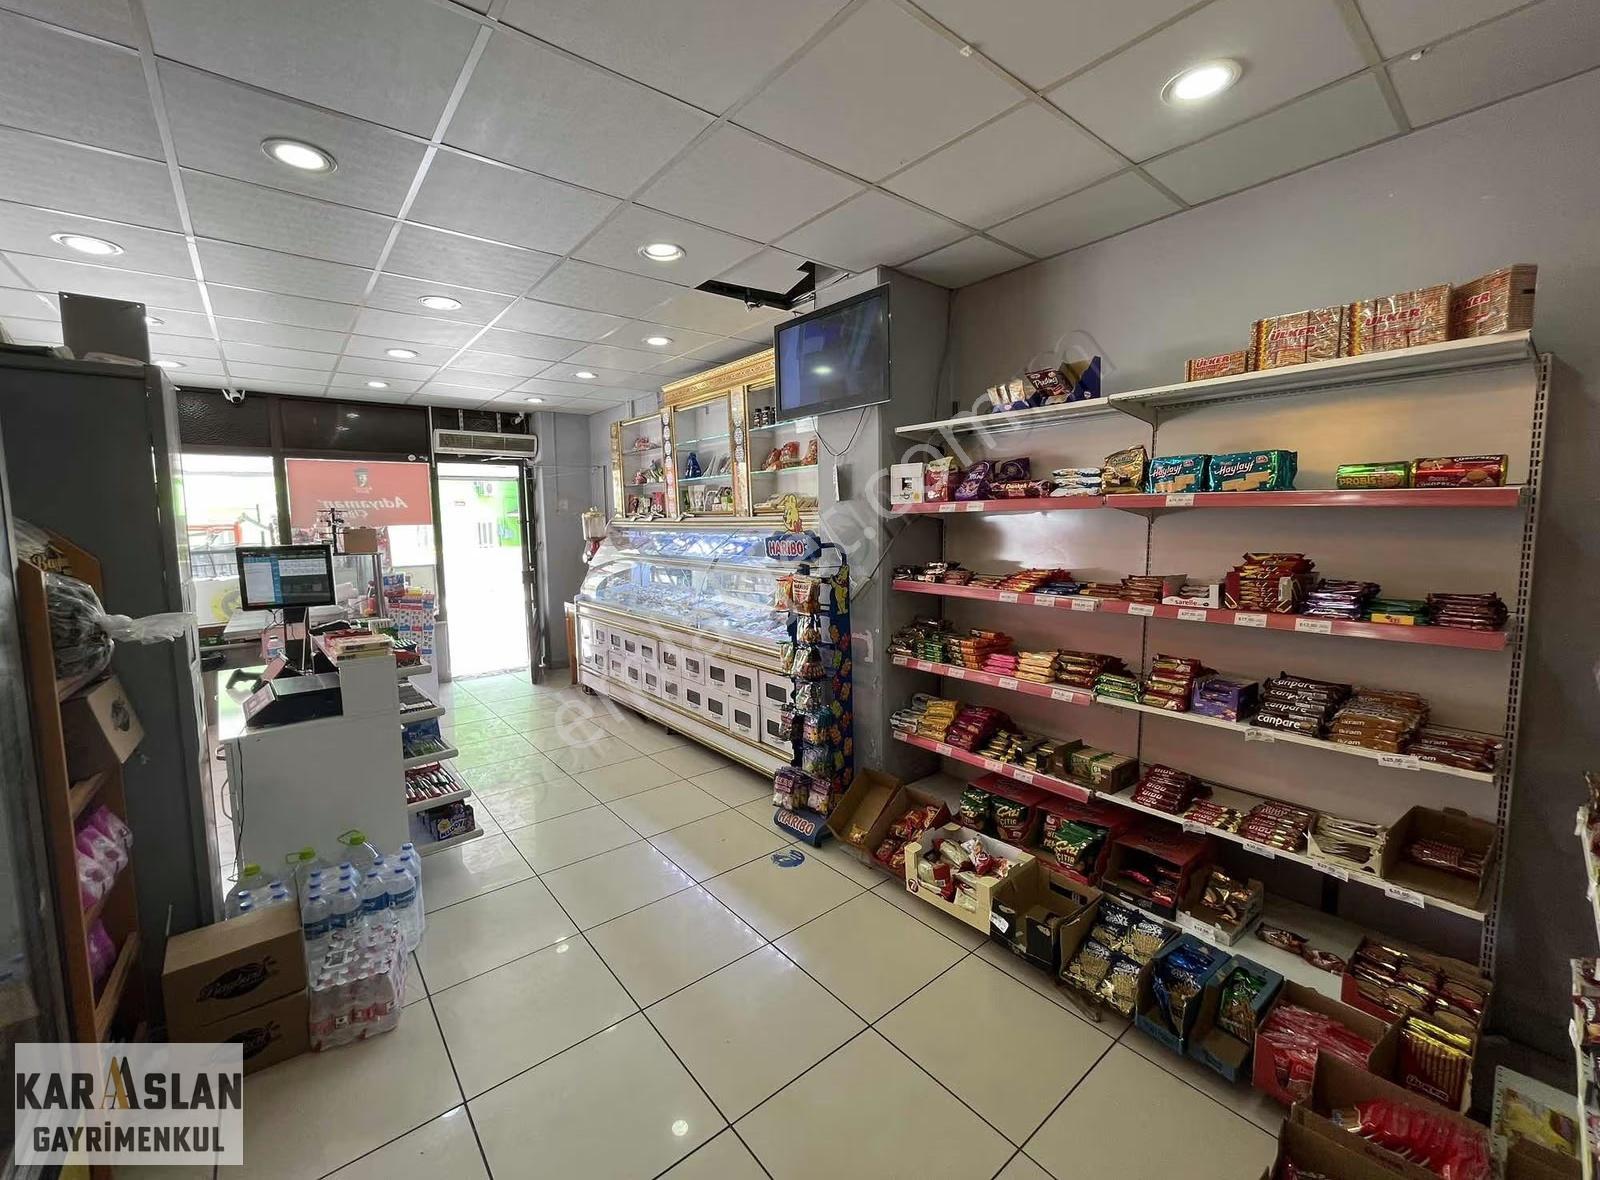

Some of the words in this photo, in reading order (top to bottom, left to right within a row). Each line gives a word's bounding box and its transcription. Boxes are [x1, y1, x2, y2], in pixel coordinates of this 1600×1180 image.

[1149, 464, 1182, 478] Haylayf
[1215, 461, 1255, 476] Haylayf
[768, 540, 804, 556] HARIBO
[1272, 679, 1315, 690] canpare
[1264, 701, 1307, 713] canpare
[1257, 714, 1301, 729] canpare
[777, 810, 816, 837] HARIBO
